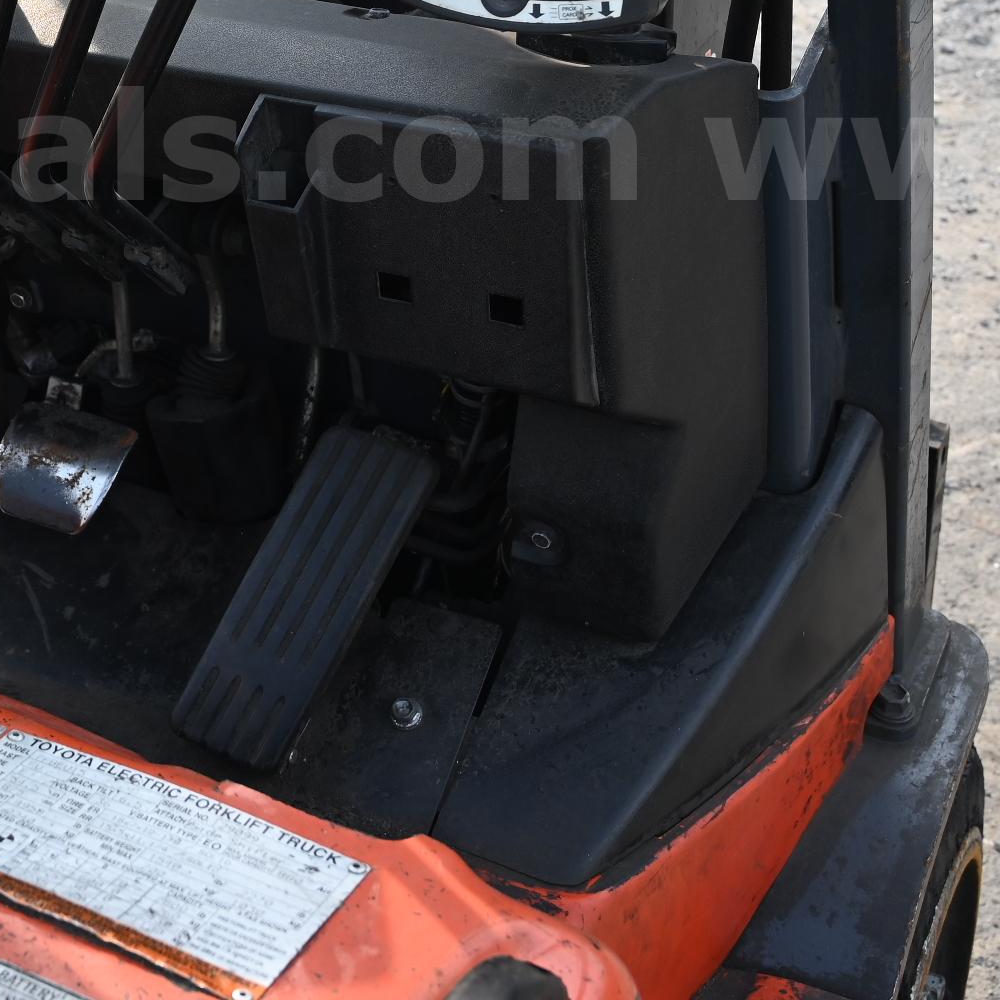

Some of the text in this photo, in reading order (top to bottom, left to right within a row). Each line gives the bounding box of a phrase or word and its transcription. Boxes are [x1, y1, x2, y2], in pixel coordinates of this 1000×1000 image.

[3, 741, 30, 755] MODEL
[53, 781, 91, 799] VOLTAGE
[70, 776, 114, 796] BACK TILT
[30, 738, 94, 767] TOYOTA
[96, 761, 181, 799] ELECTRIC
[185, 793, 275, 835] FORKLIFT
[277, 831, 343, 865] TRUCK
[135, 813, 174, 831] BATTERY
[176, 828, 198, 841] TYPE
